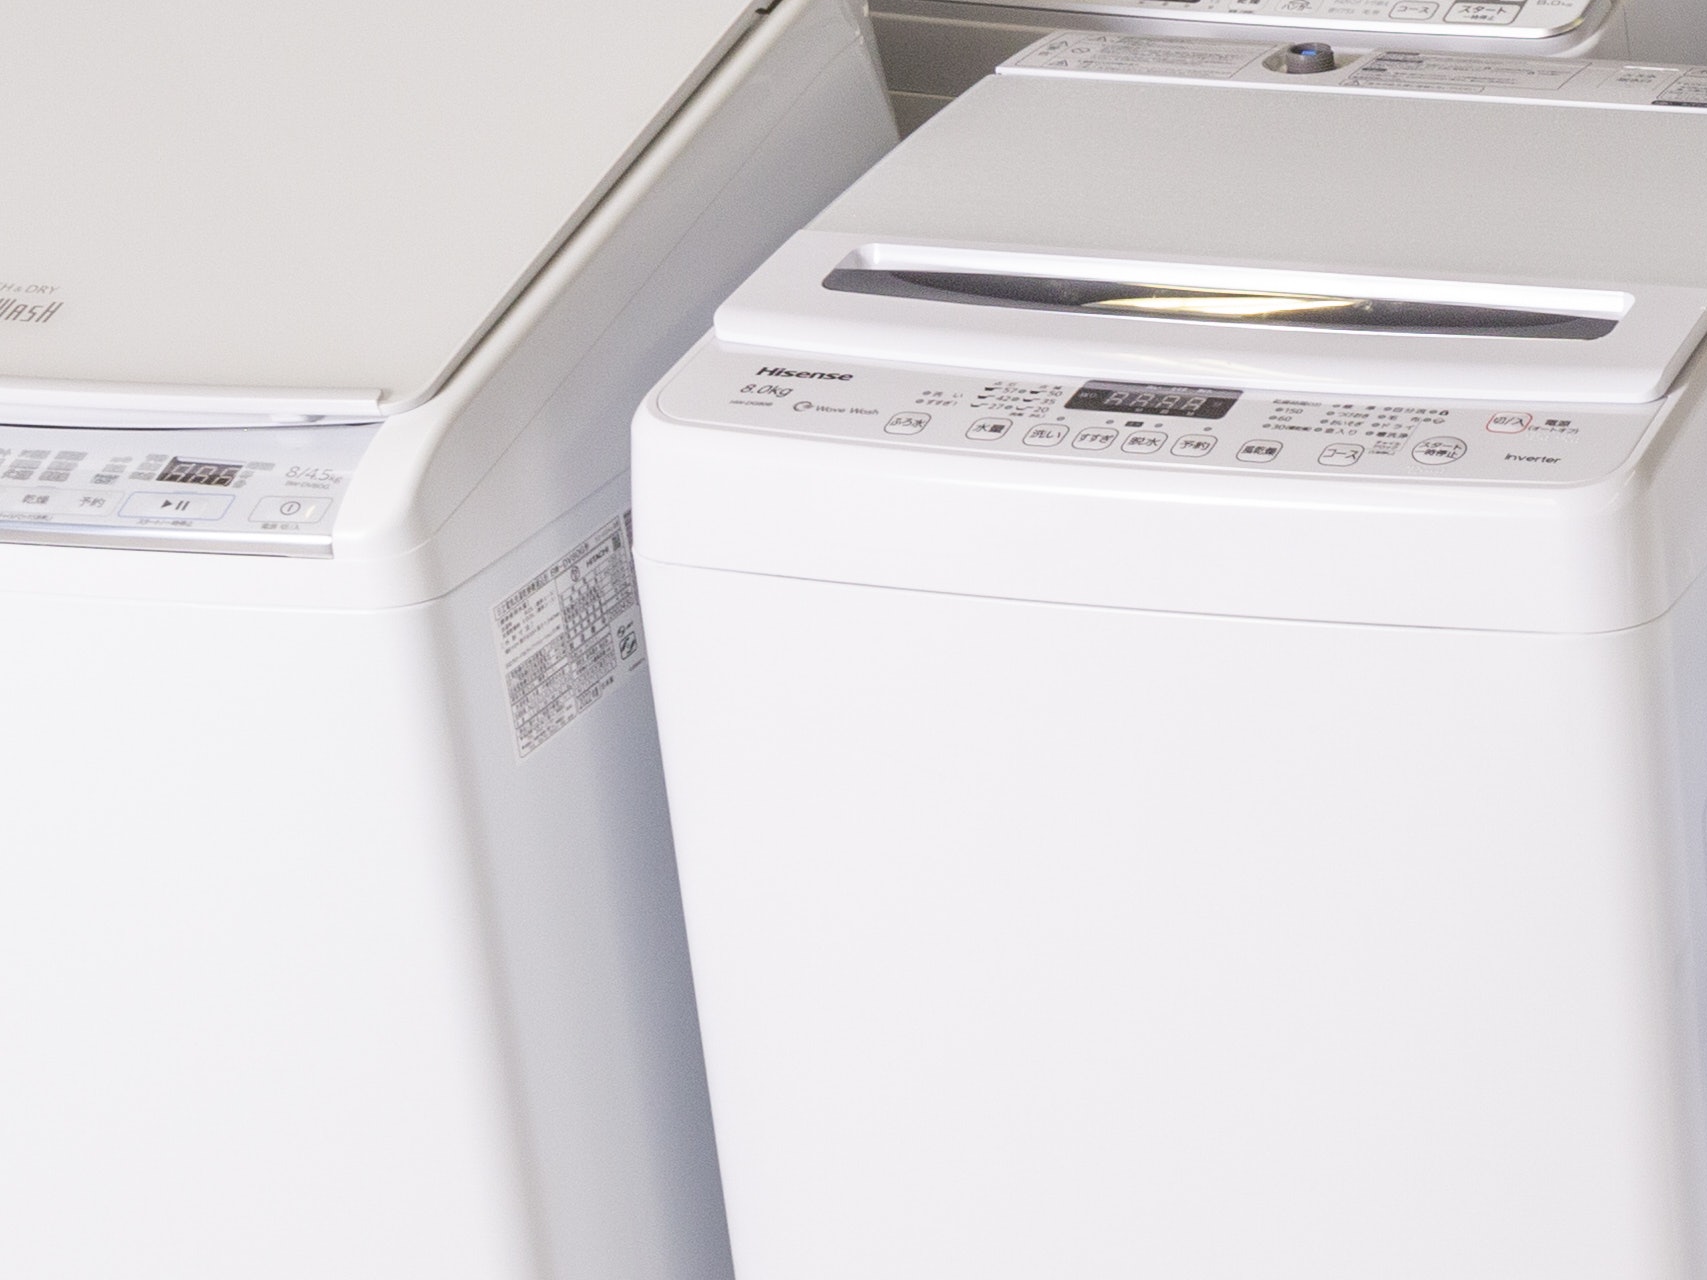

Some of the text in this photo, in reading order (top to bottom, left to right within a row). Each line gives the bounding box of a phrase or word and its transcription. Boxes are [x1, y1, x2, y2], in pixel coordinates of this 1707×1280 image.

[1397, 5, 1429, 14] コース
[1458, 5, 1508, 14] スタート
[25, 284, 60, 295] DRY
[756, 366, 854, 381] Hisense
[740, 383, 794, 398] 8.0kg
[1079, 433, 1115, 443] すすぎ
[1179, 440, 1211, 450] 予約
[1421, 441, 1461, 450] スタート
[1322, 448, 1358, 460] コース
